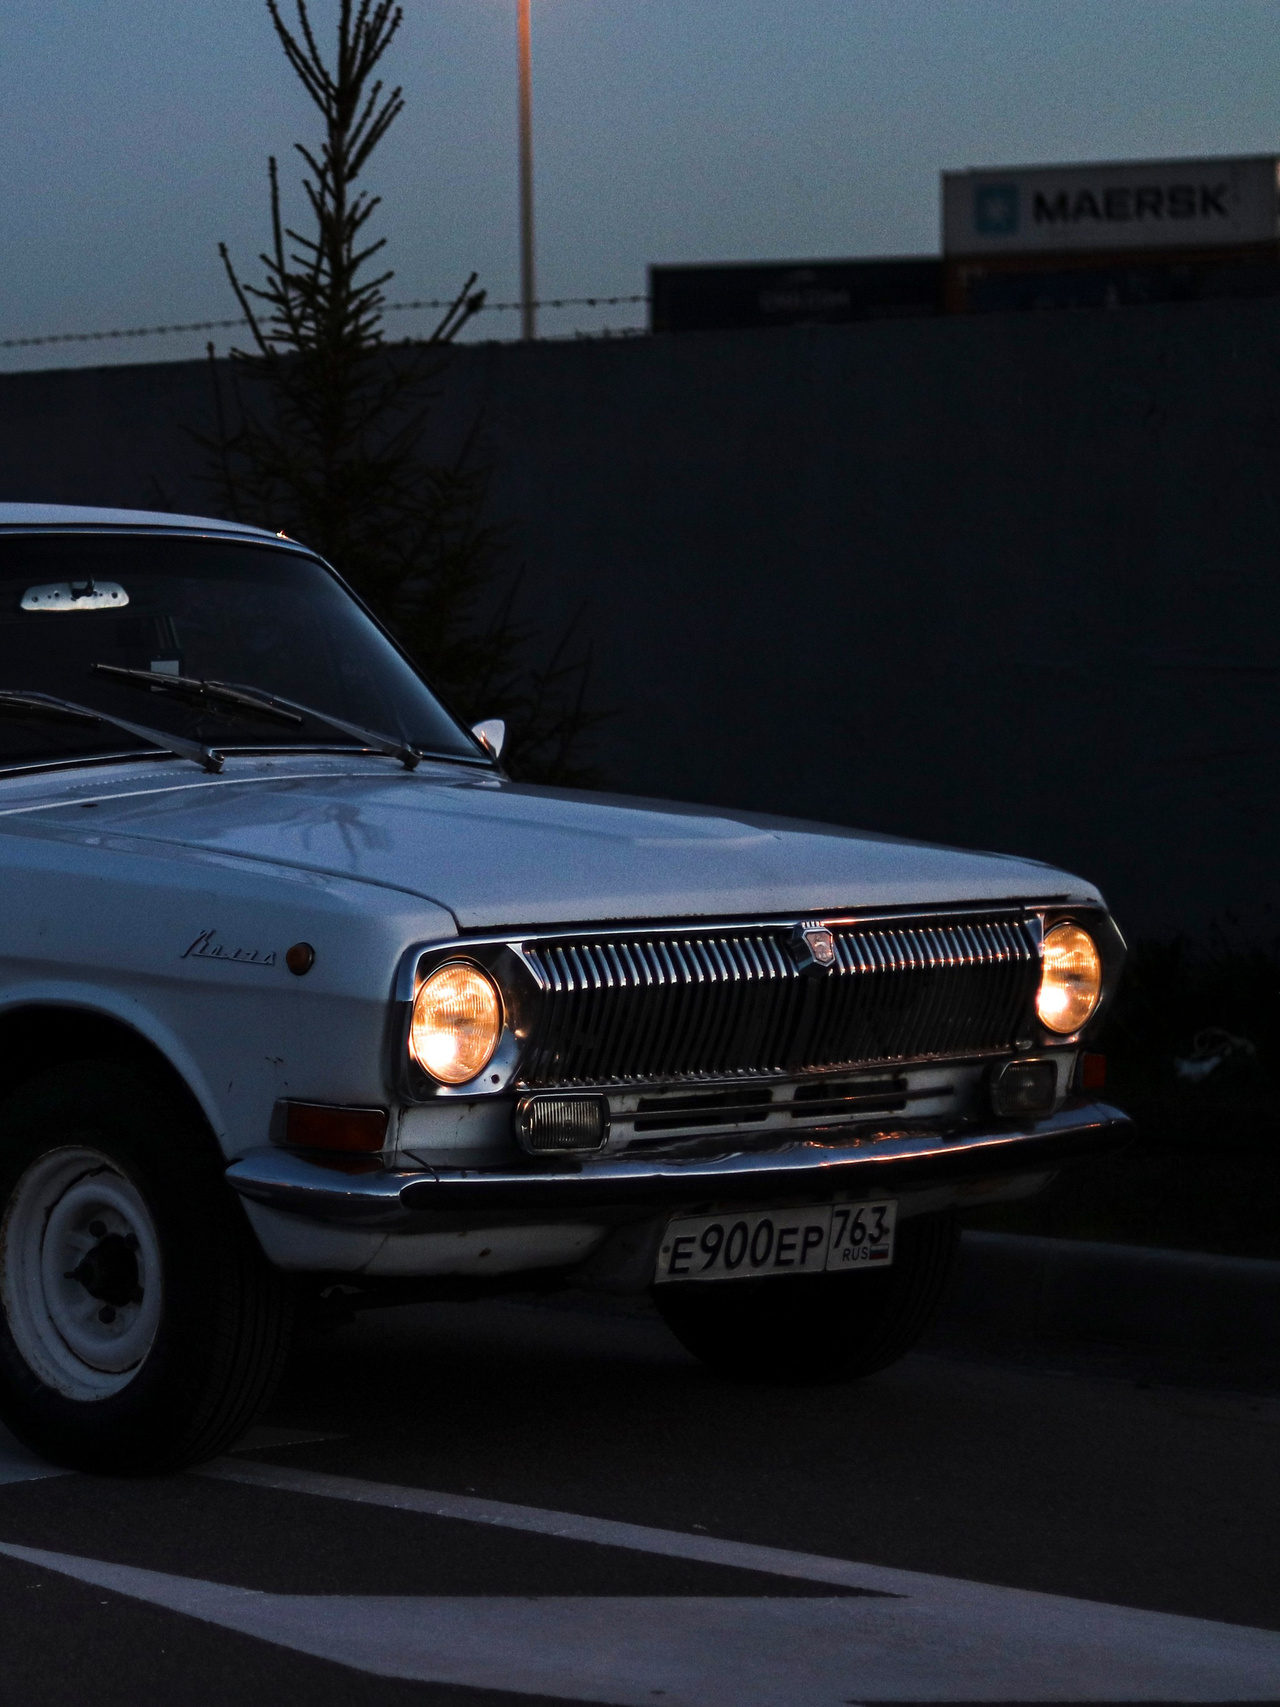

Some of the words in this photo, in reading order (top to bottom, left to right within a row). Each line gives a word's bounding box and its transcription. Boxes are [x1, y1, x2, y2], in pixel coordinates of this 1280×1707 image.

[1032, 183, 1228, 222] MAERSK
[668, 1218, 824, 1275] E900EP
[833, 1206, 888, 1249] 763
[841, 1246, 869, 1262] RUS
